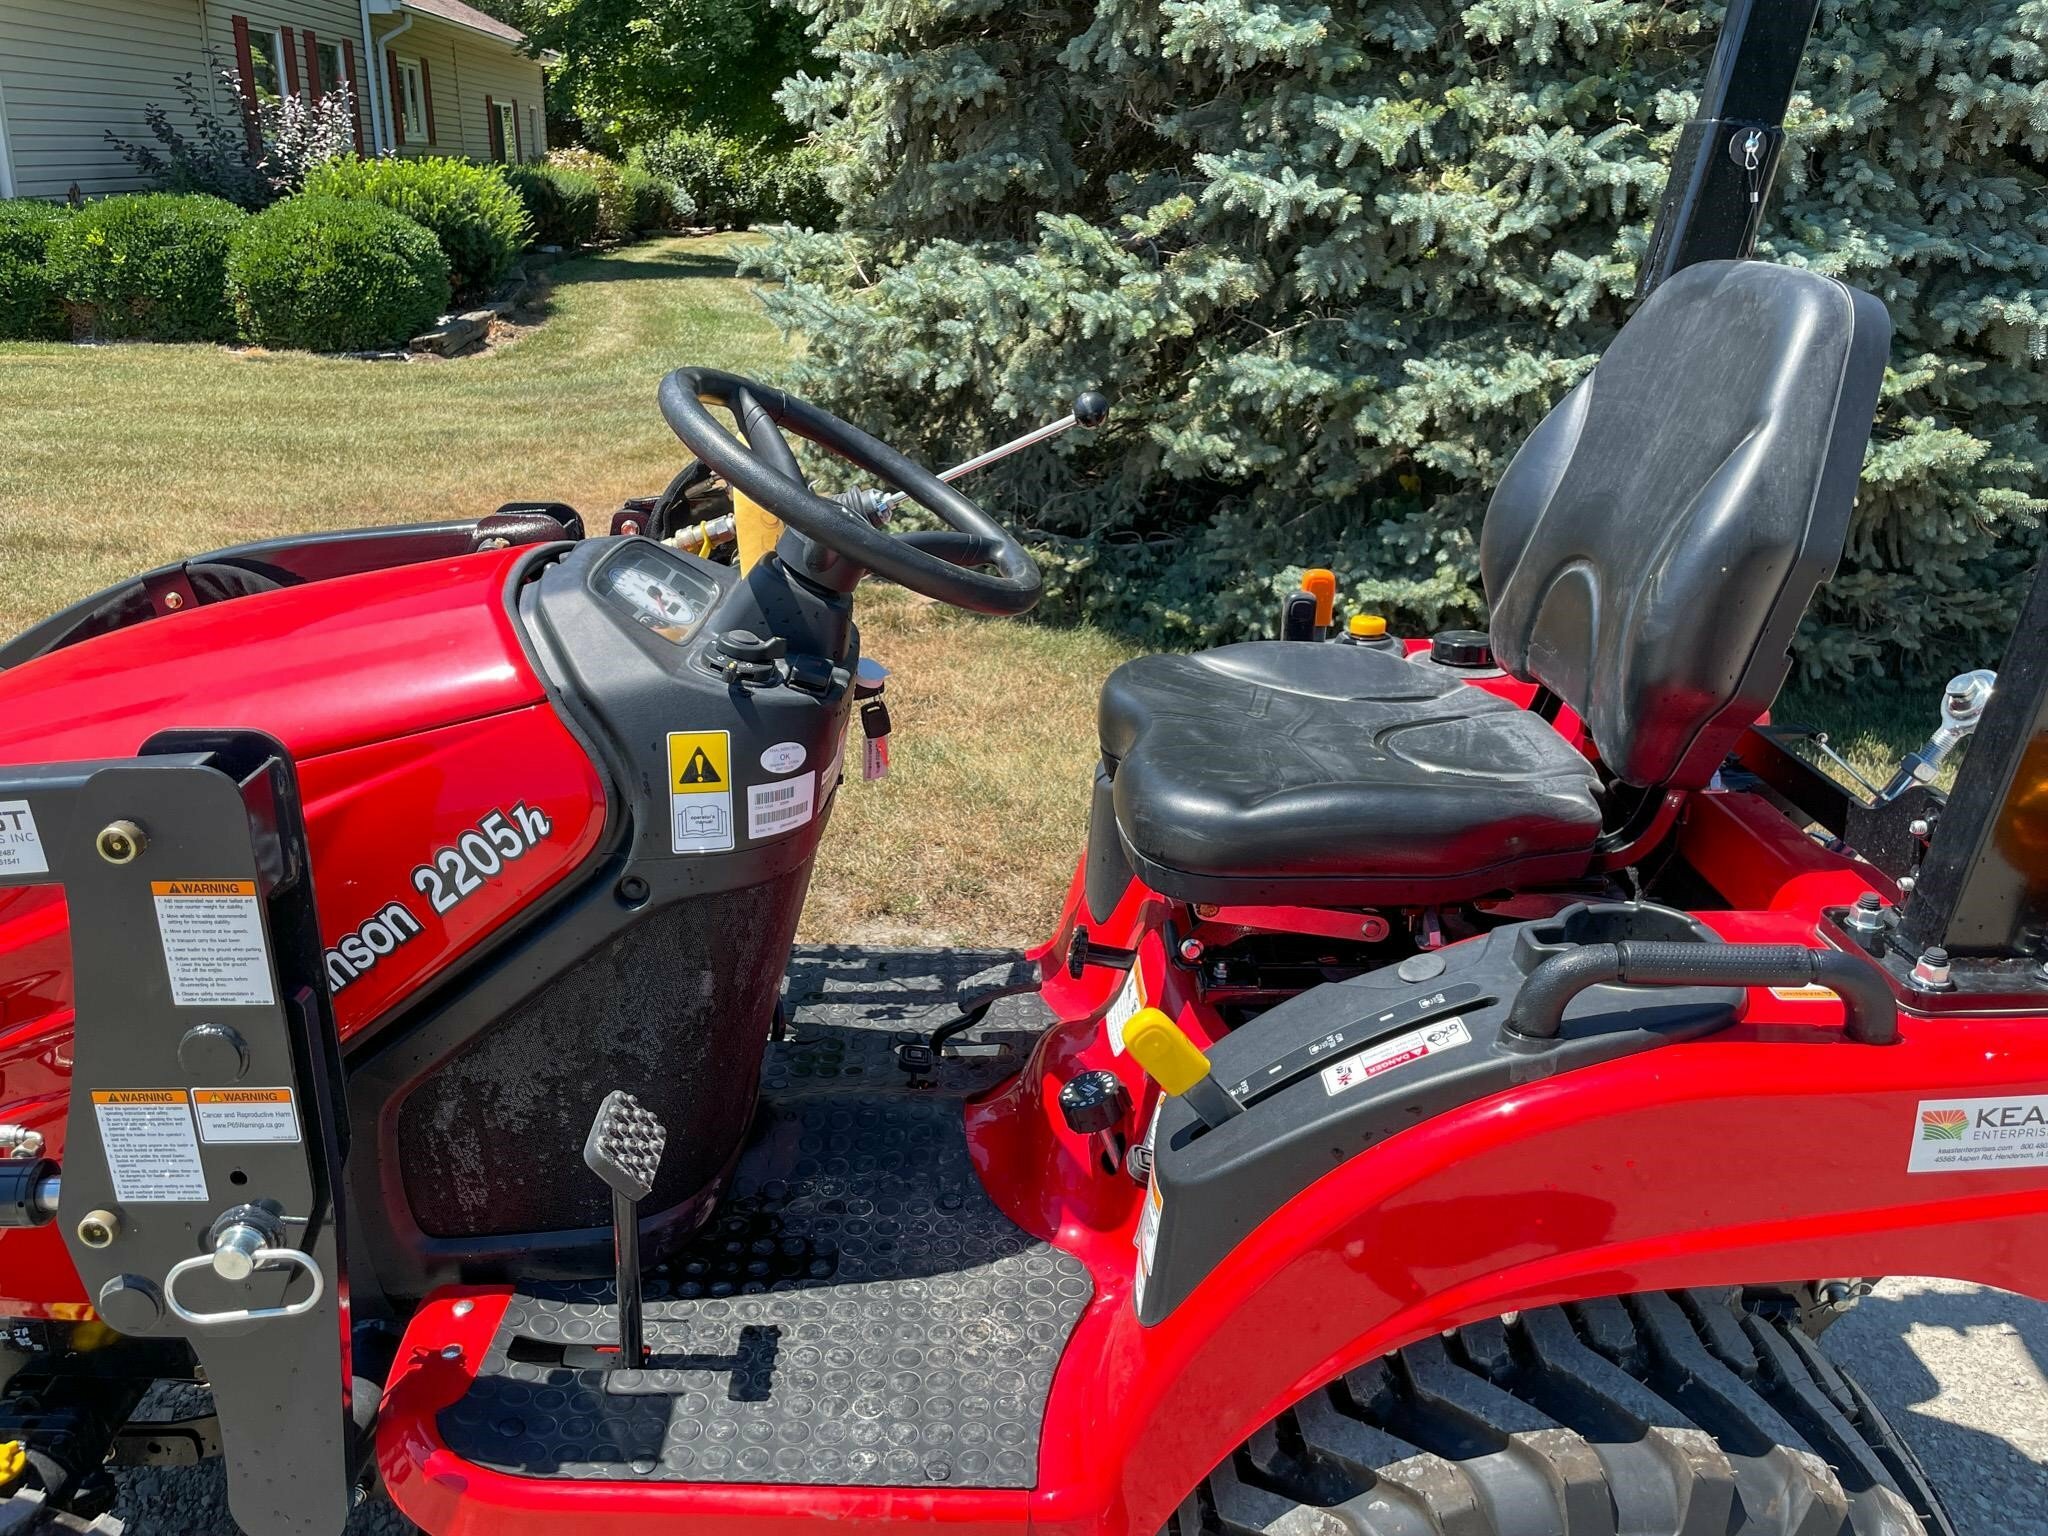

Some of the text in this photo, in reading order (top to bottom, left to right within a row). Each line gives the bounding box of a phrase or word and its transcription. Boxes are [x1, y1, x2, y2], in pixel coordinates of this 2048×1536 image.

[780, 753, 791, 761] OK
[10, 832, 35, 843] INC
[414, 806, 549, 914] 2205h
[181, 883, 240, 894] WARNING
[1369, 1053, 1410, 1073] DANGER
[120, 1092, 173, 1102] WARNING
[223, 1092, 278, 1101] WARNING
[237, 1111, 274, 1119] Reproductive
[1976, 1105, 2048, 1128] KEA
